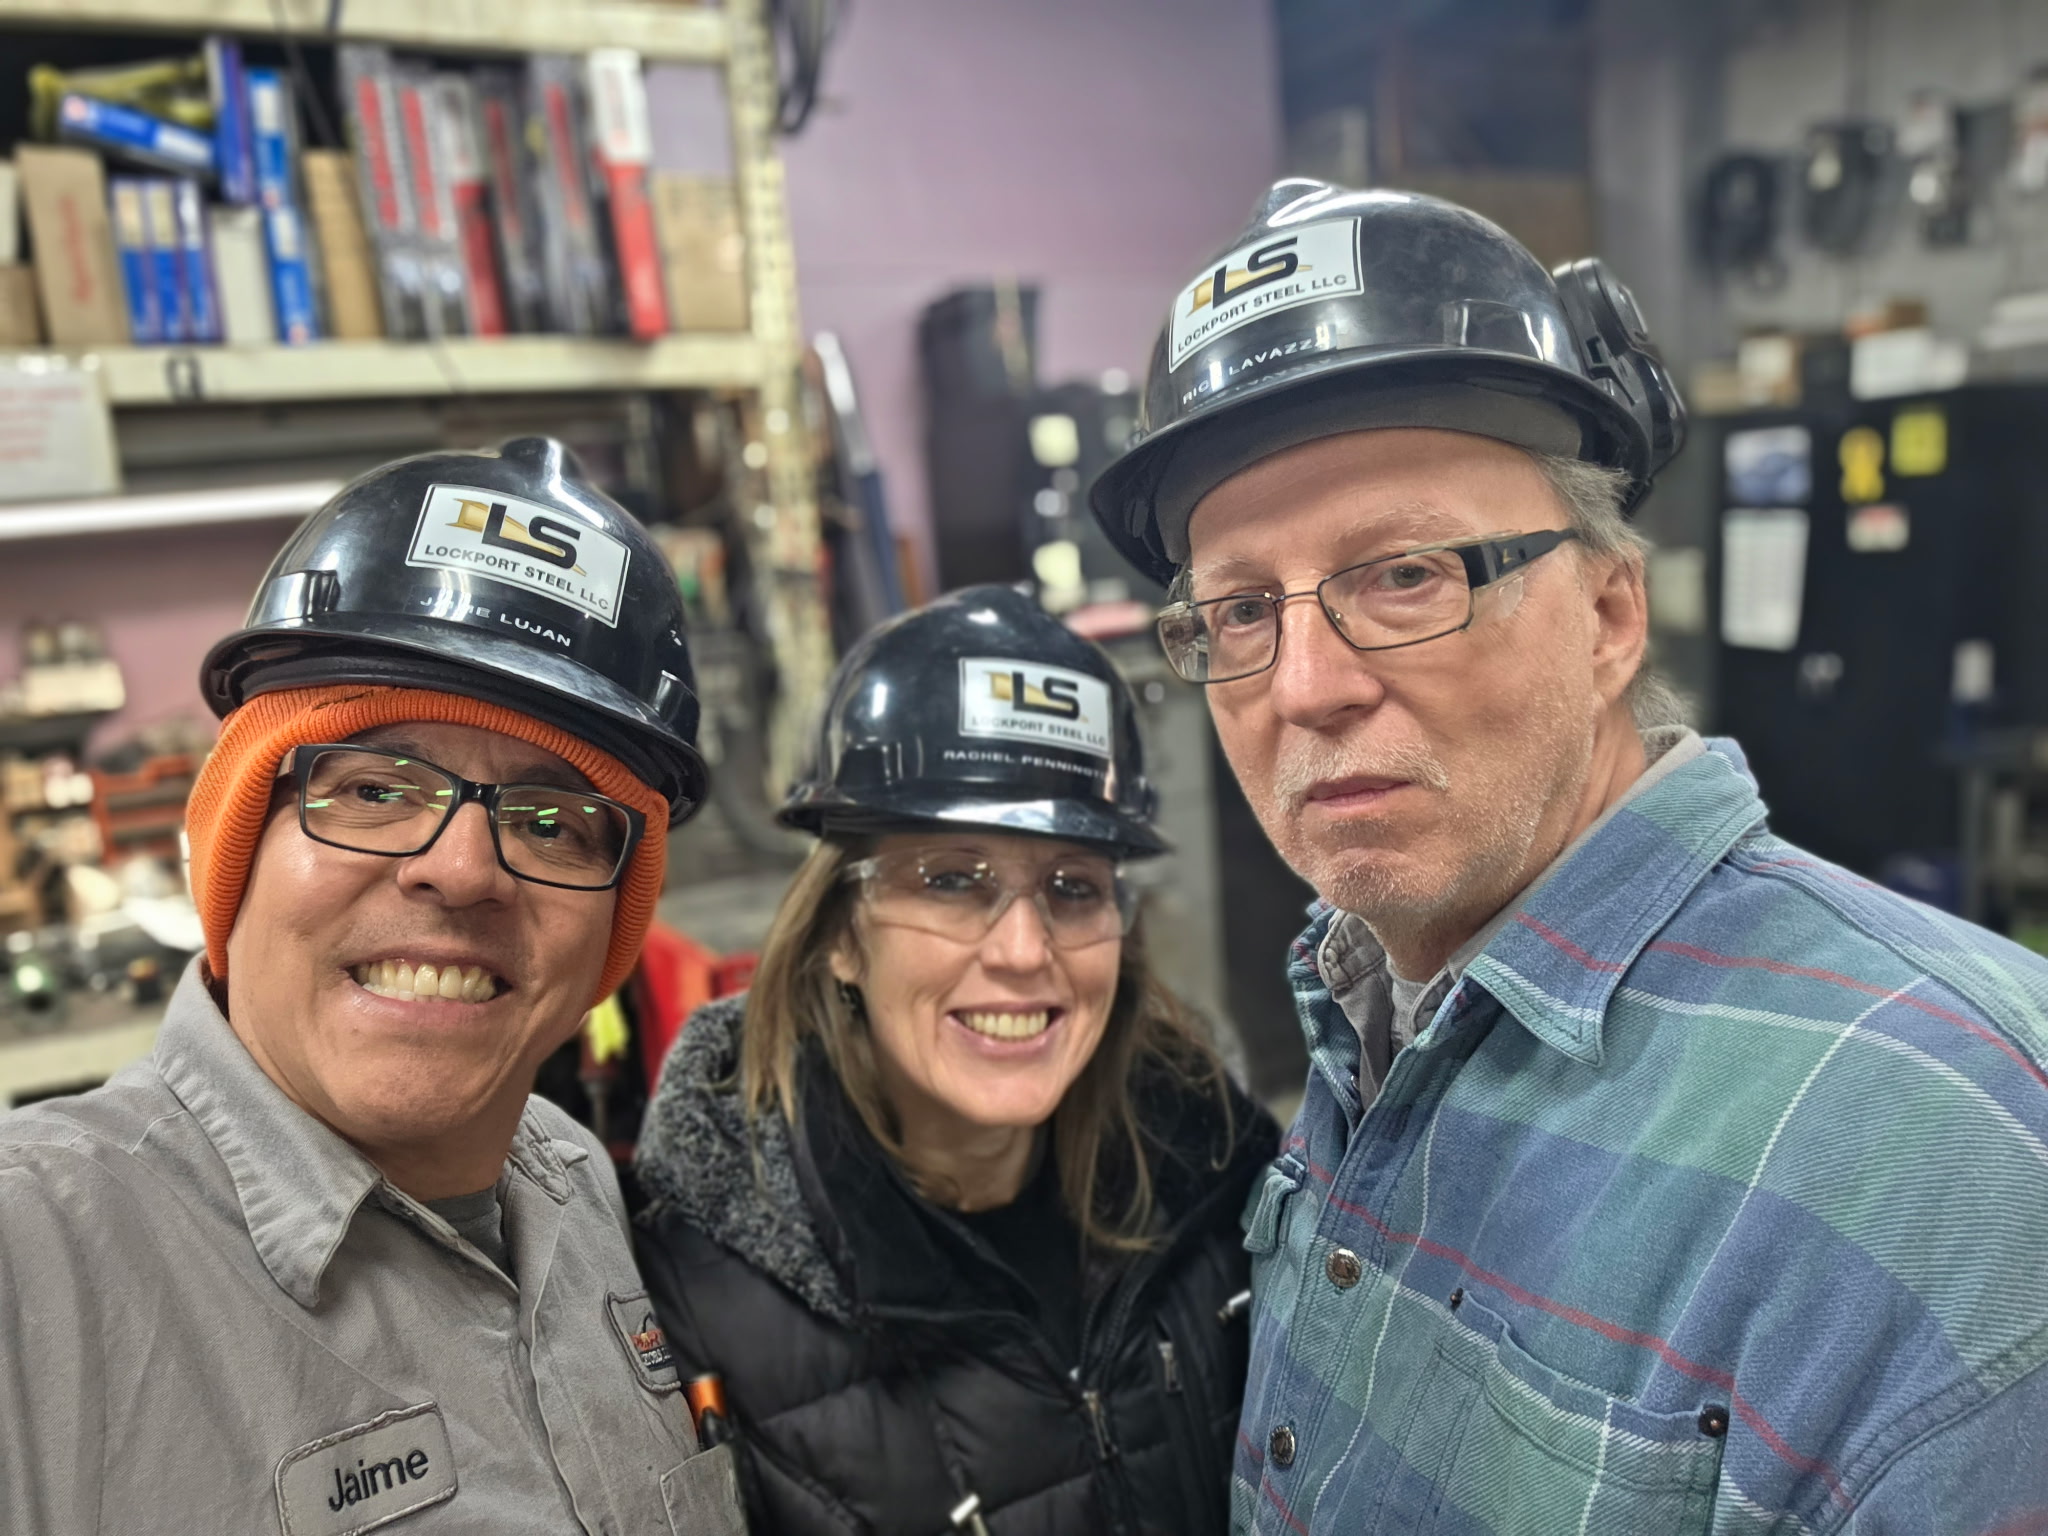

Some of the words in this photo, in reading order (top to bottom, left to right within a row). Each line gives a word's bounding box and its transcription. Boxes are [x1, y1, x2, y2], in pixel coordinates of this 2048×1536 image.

[1212, 235, 1299, 310] LS
[1177, 301, 1249, 354] LOCKPORT
[1253, 283, 1307, 308] STEEL
[1311, 274, 1347, 290] LLC
[1182, 376, 1222, 405] RIC
[1228, 337, 1329, 376] LAVAZZ
[481, 502, 581, 570] LS
[424, 544, 520, 573] LOCKPORT
[524, 565, 575, 594] STEEL
[580, 587, 609, 610] LLC
[499, 613, 571, 647] LUJAN
[1012, 670, 1081, 721] LS
[943, 749, 1015, 764] RACHEL
[1048, 723, 1083, 741] STEEL
[1086, 733, 1106, 746] LLC
[328, 1449, 429, 1513] Jaime
